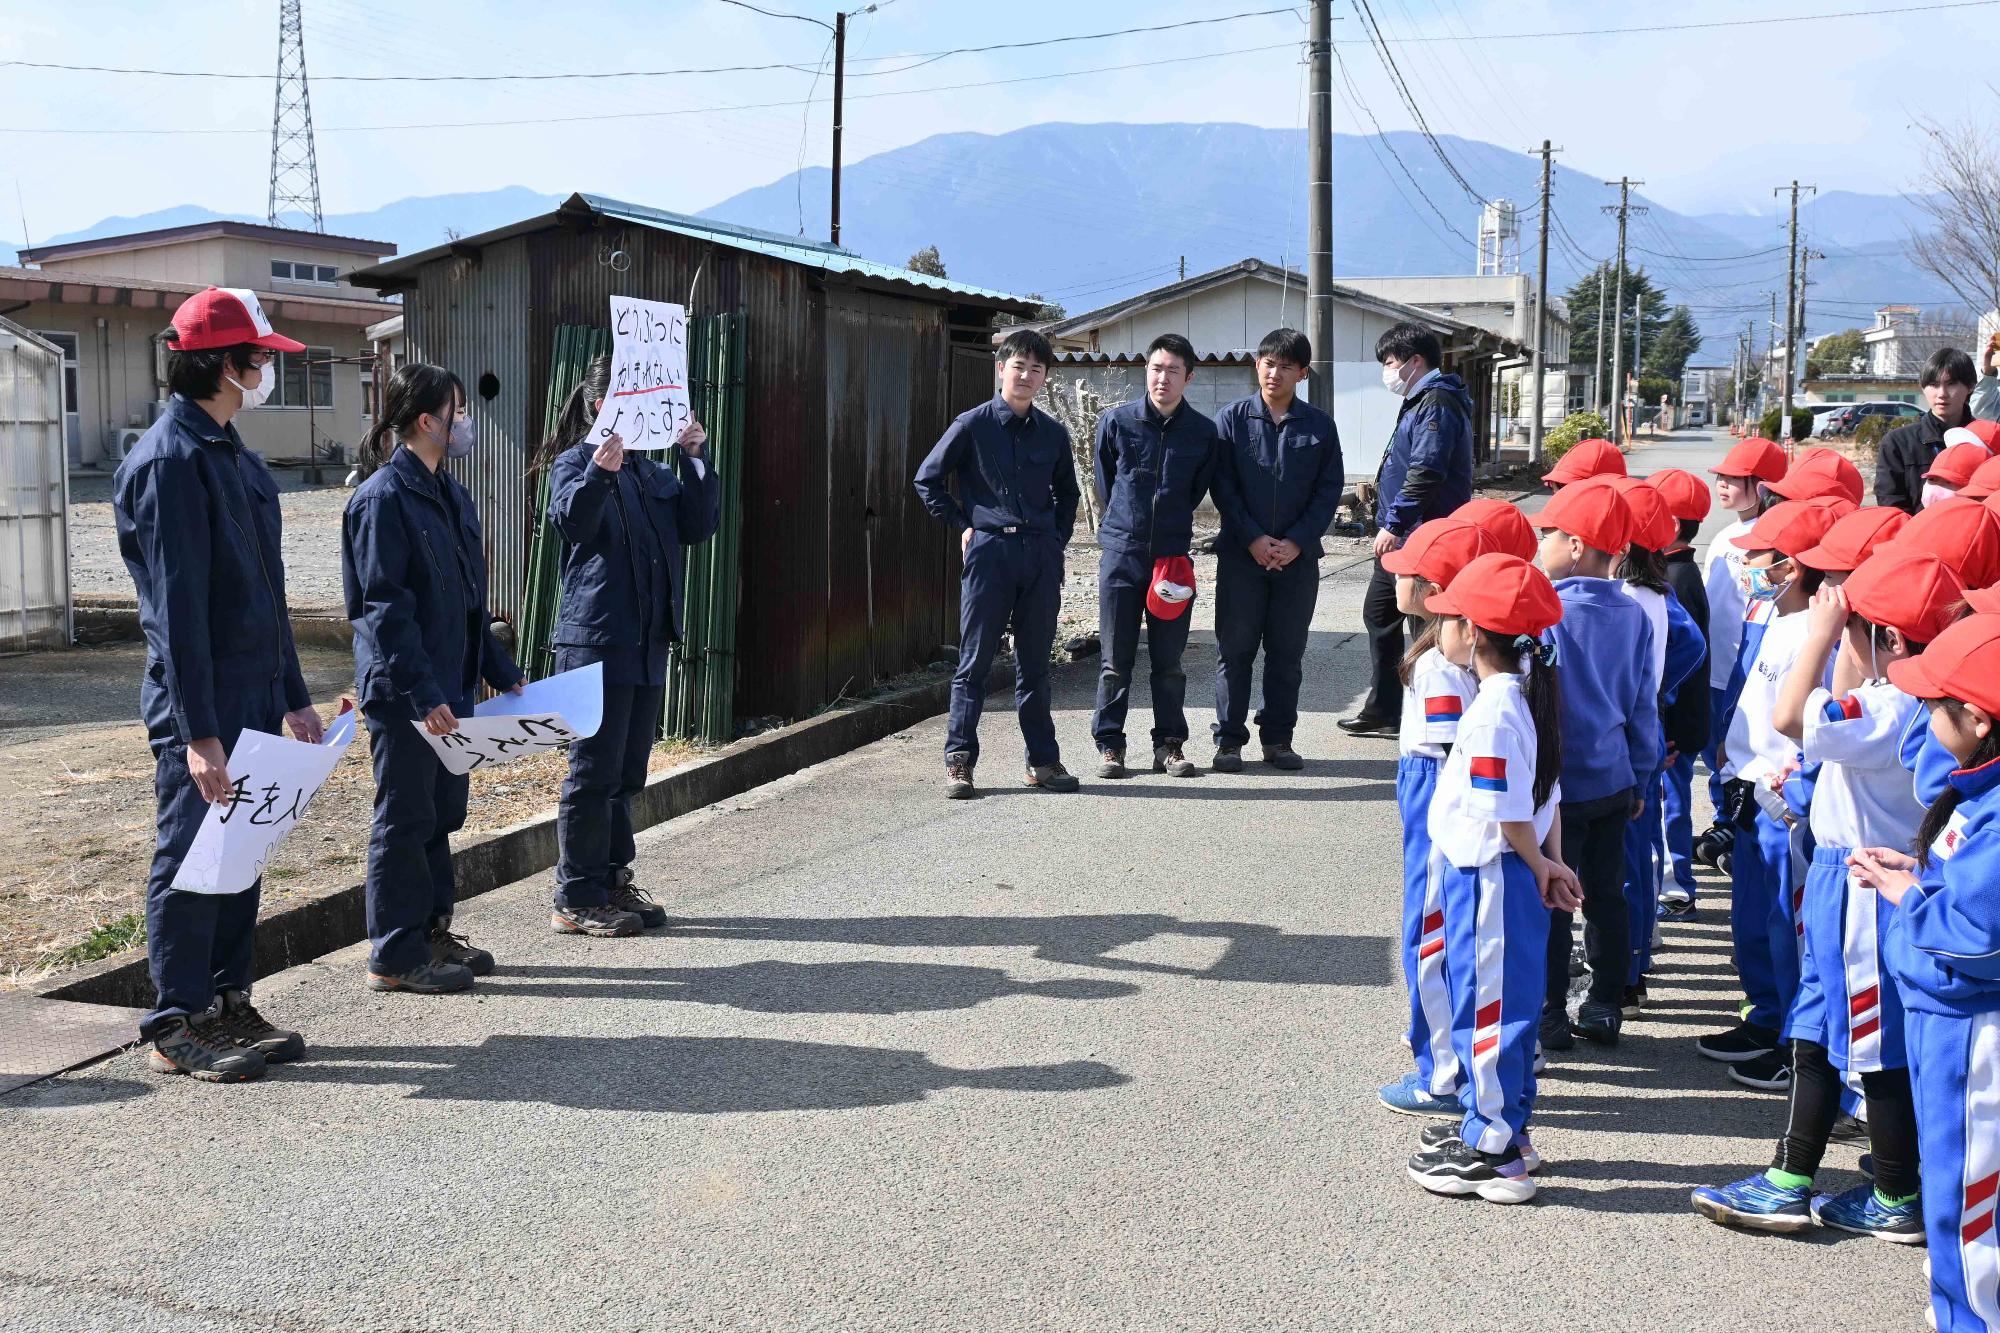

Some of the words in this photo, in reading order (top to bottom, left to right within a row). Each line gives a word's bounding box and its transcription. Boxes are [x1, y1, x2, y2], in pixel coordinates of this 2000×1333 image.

[616, 305, 683, 344] どうぶつに
[616, 360, 681, 391] かまれない
[600, 398, 689, 444] ようにする
